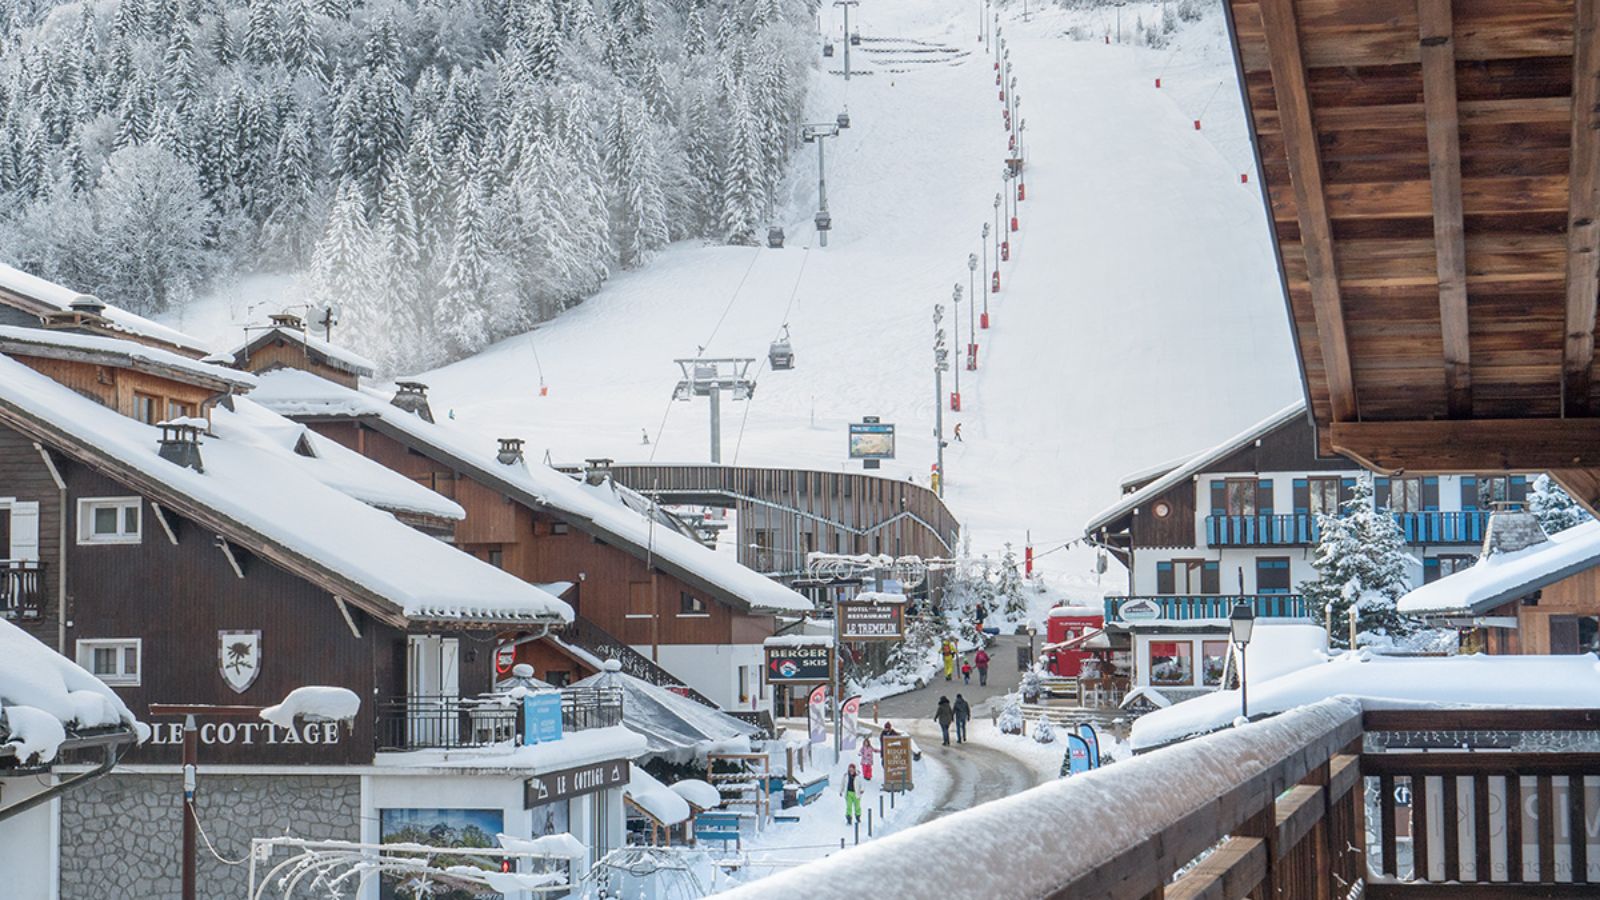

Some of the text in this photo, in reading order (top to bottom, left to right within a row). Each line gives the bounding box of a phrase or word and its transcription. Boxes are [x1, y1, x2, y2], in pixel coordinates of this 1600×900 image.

[847, 623, 897, 634] LE TREMPLIN
[770, 649, 827, 657] BERGER
[150, 722, 339, 744] LE COTTAGE
[556, 767, 604, 795] LE COTTAGE
